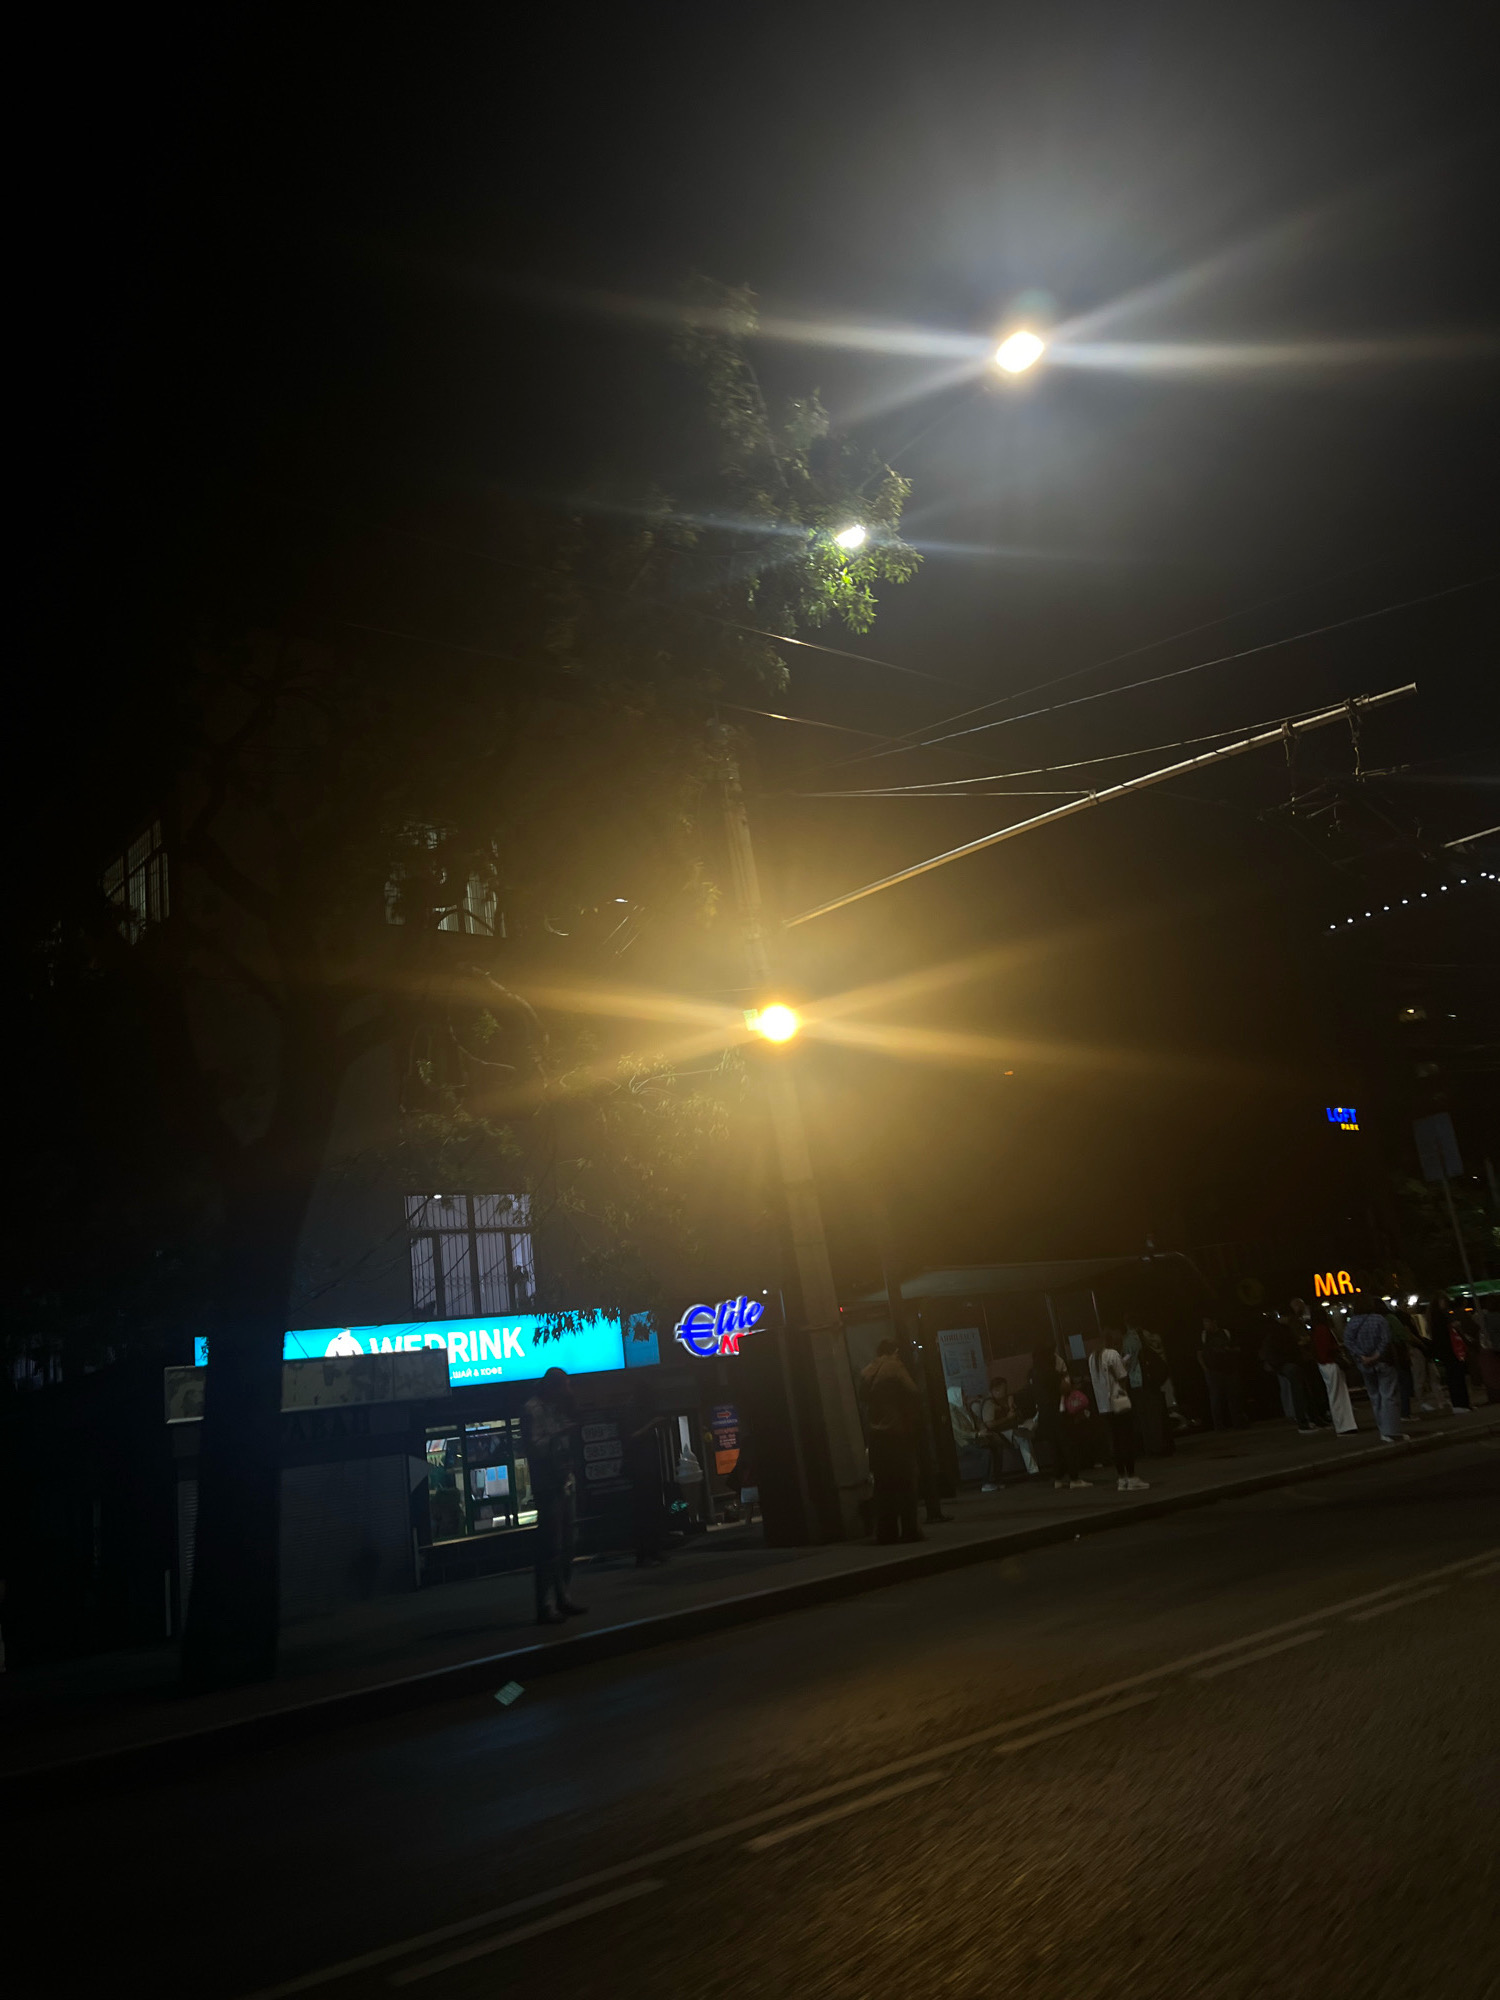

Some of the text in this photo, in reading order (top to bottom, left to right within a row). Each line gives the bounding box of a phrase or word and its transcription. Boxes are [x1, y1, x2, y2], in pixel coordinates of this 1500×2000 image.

[1326, 1108, 1357, 1123] LOFT
[1314, 1270, 1361, 1298] MR.
[481, 1366, 503, 1376] КОФЕ
